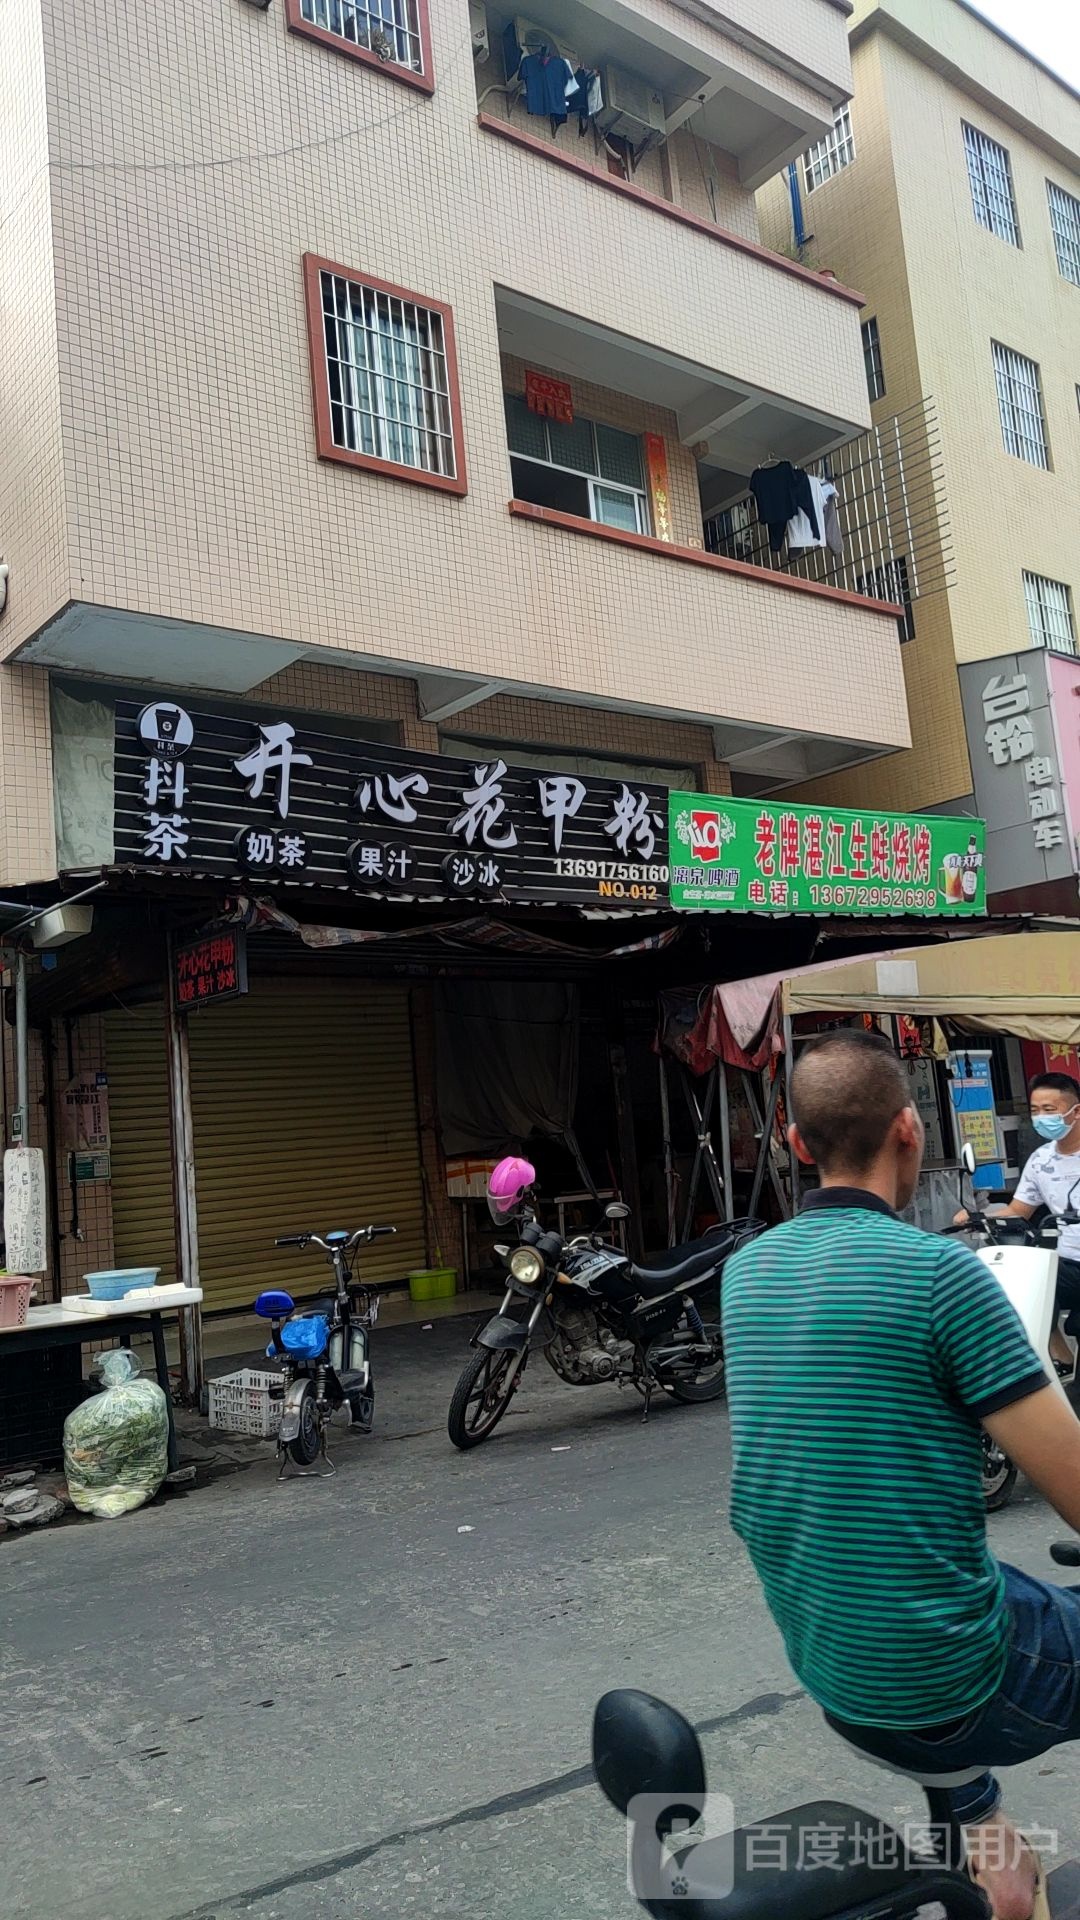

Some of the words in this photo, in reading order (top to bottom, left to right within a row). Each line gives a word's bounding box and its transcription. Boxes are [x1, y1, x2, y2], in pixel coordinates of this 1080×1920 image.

[982, 673, 1035, 766] 台铃
[144, 757, 190, 861] 抖茶
[233, 721, 664, 860] 开心花甲粉
[1024, 756, 1064, 849] 电动车
[246, 831, 306, 868] 奶茶
[358, 846, 412, 879] 果汁
[754, 810, 932, 885] 老牌湛江生蚝烧烤
[452, 858, 500, 887] 沙冰
[553, 857, 669, 883] 13691756160
[598, 880, 658, 900] NO.012
[809, 884, 936, 908] 13672952638
